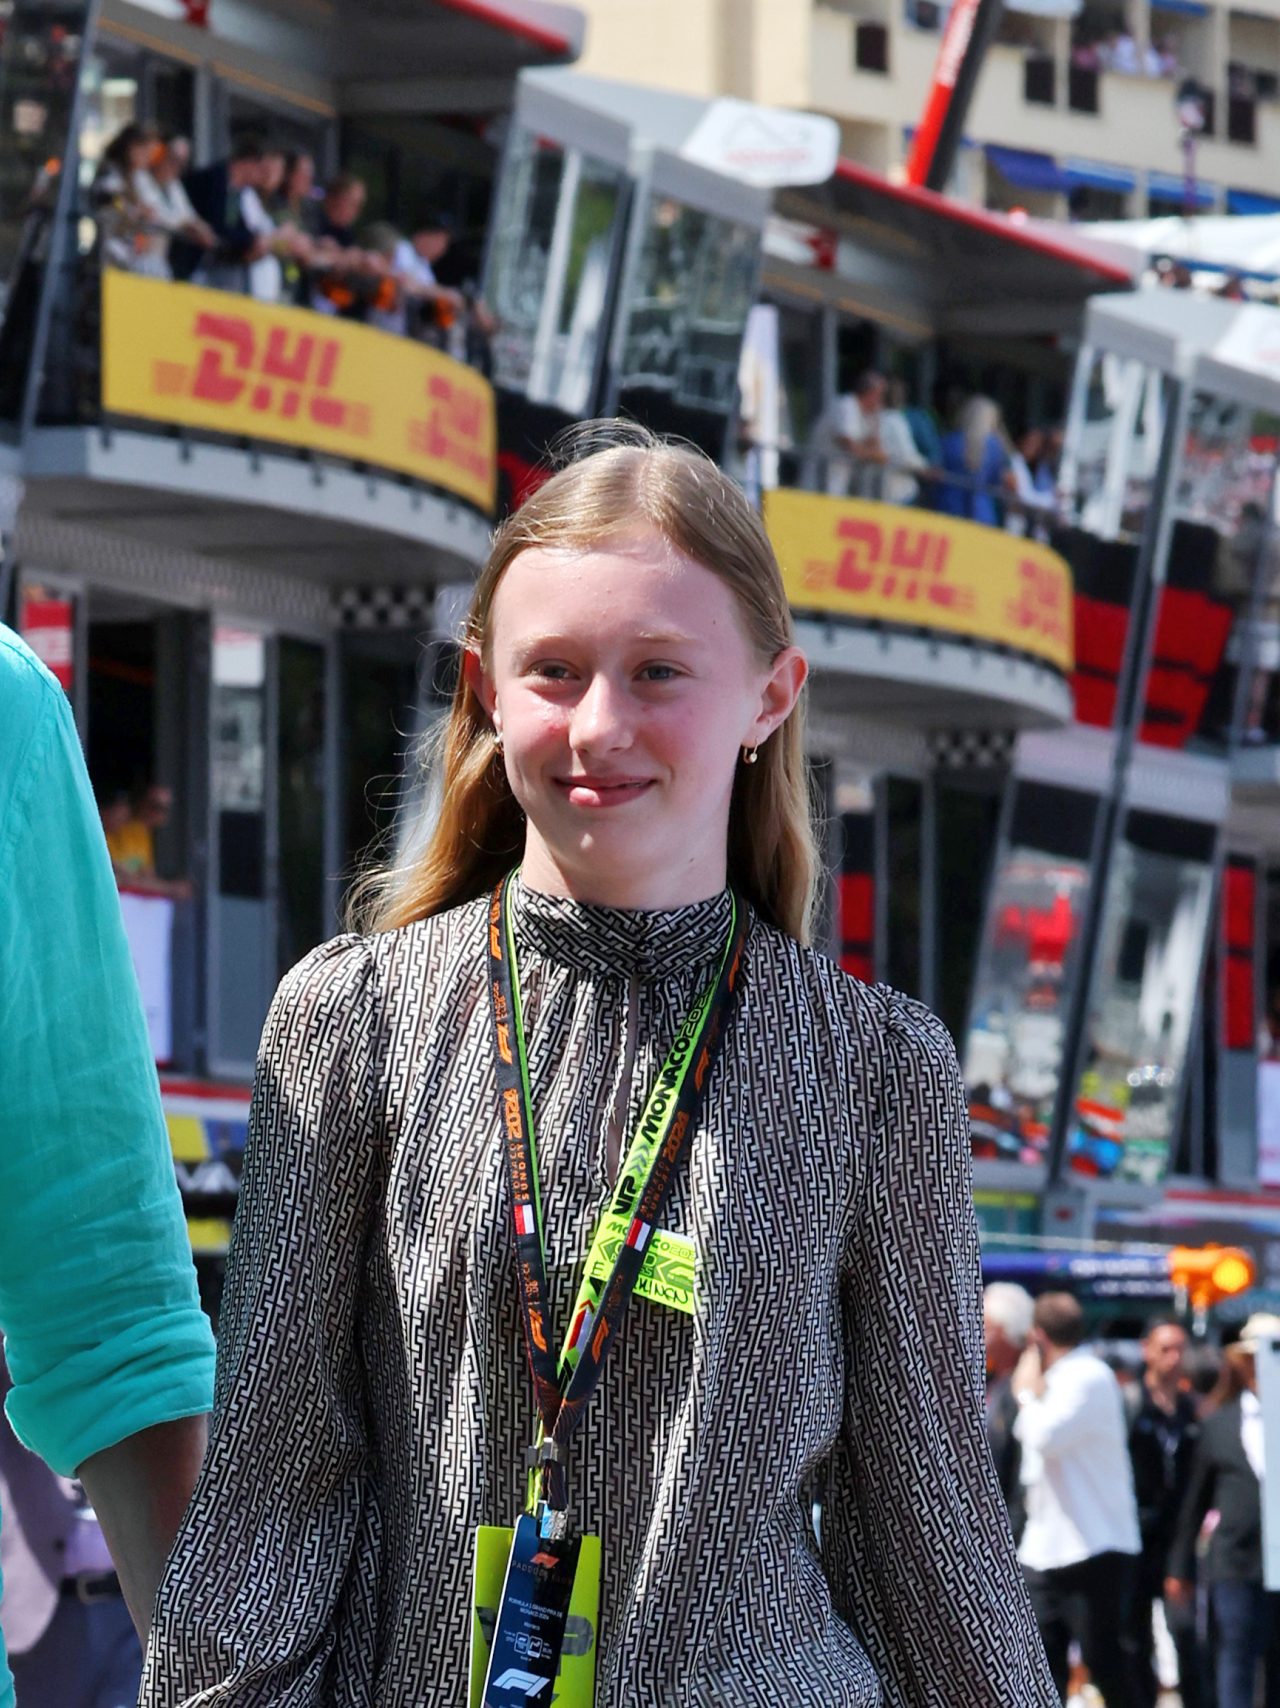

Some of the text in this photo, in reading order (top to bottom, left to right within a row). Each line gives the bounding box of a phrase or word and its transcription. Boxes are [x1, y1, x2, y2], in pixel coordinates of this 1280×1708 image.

[192, 311, 347, 428] DHL
[835, 516, 956, 608] DHL
[502, 1087, 530, 1201] SUNDAY 2024
[611, 1175, 638, 1217] VIP
